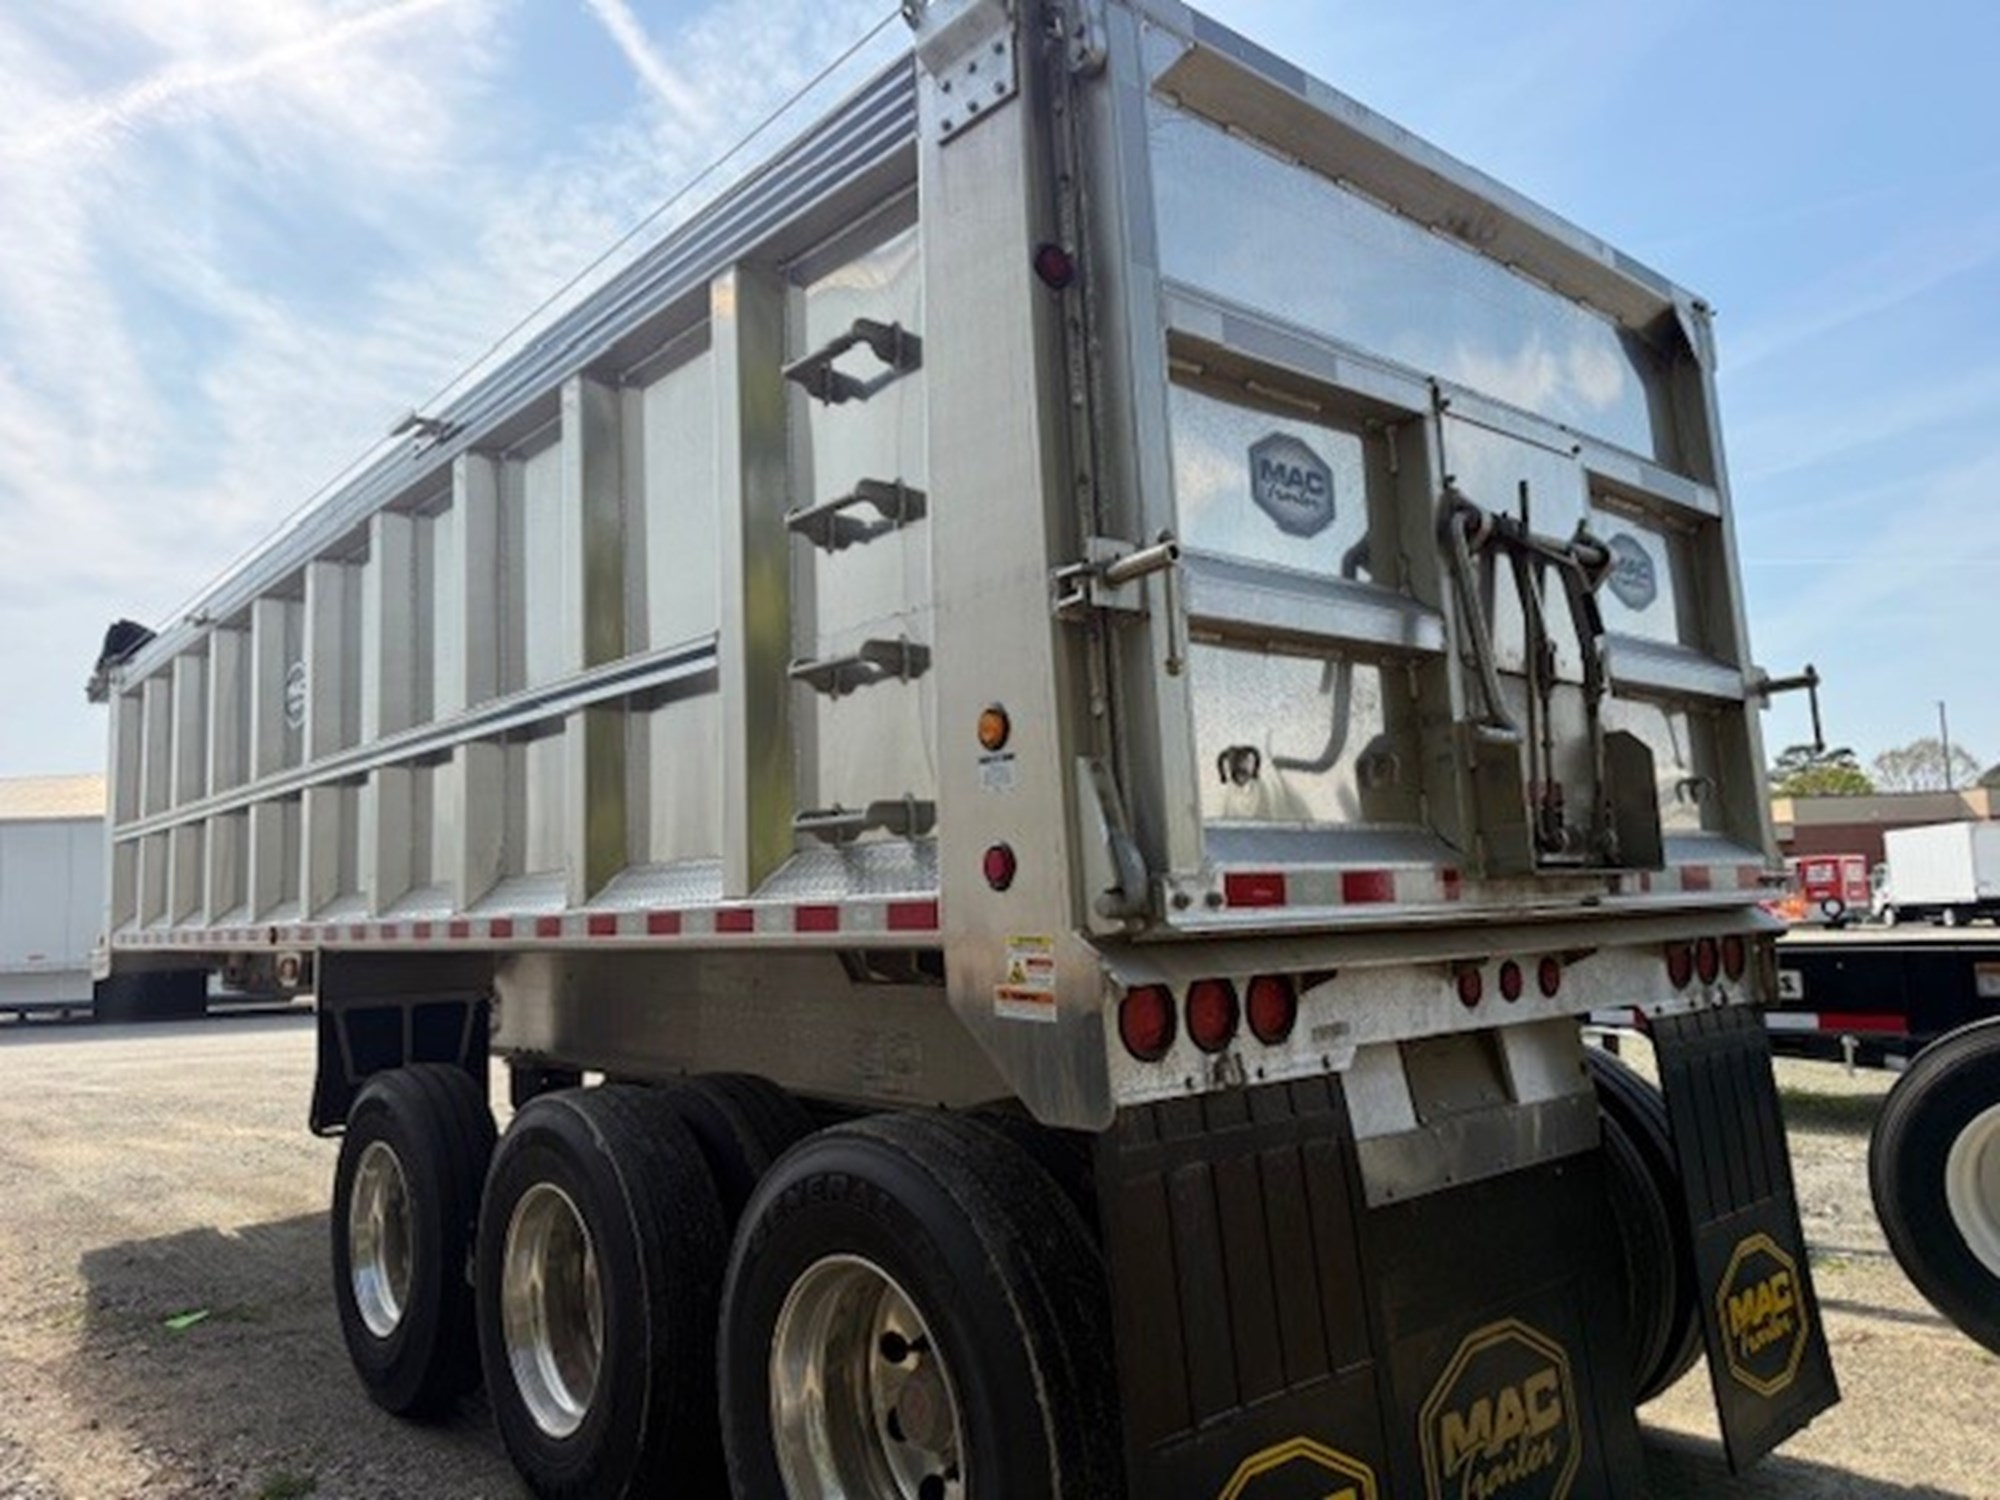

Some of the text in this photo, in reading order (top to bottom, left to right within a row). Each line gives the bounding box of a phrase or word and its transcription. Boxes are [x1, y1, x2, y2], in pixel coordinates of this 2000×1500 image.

[1259, 458, 1326, 497] MAC
[1728, 1270, 1794, 1338] MAC
[1442, 1366, 1563, 1478] MAC
[1452, 1438, 1558, 1500] Trailer
